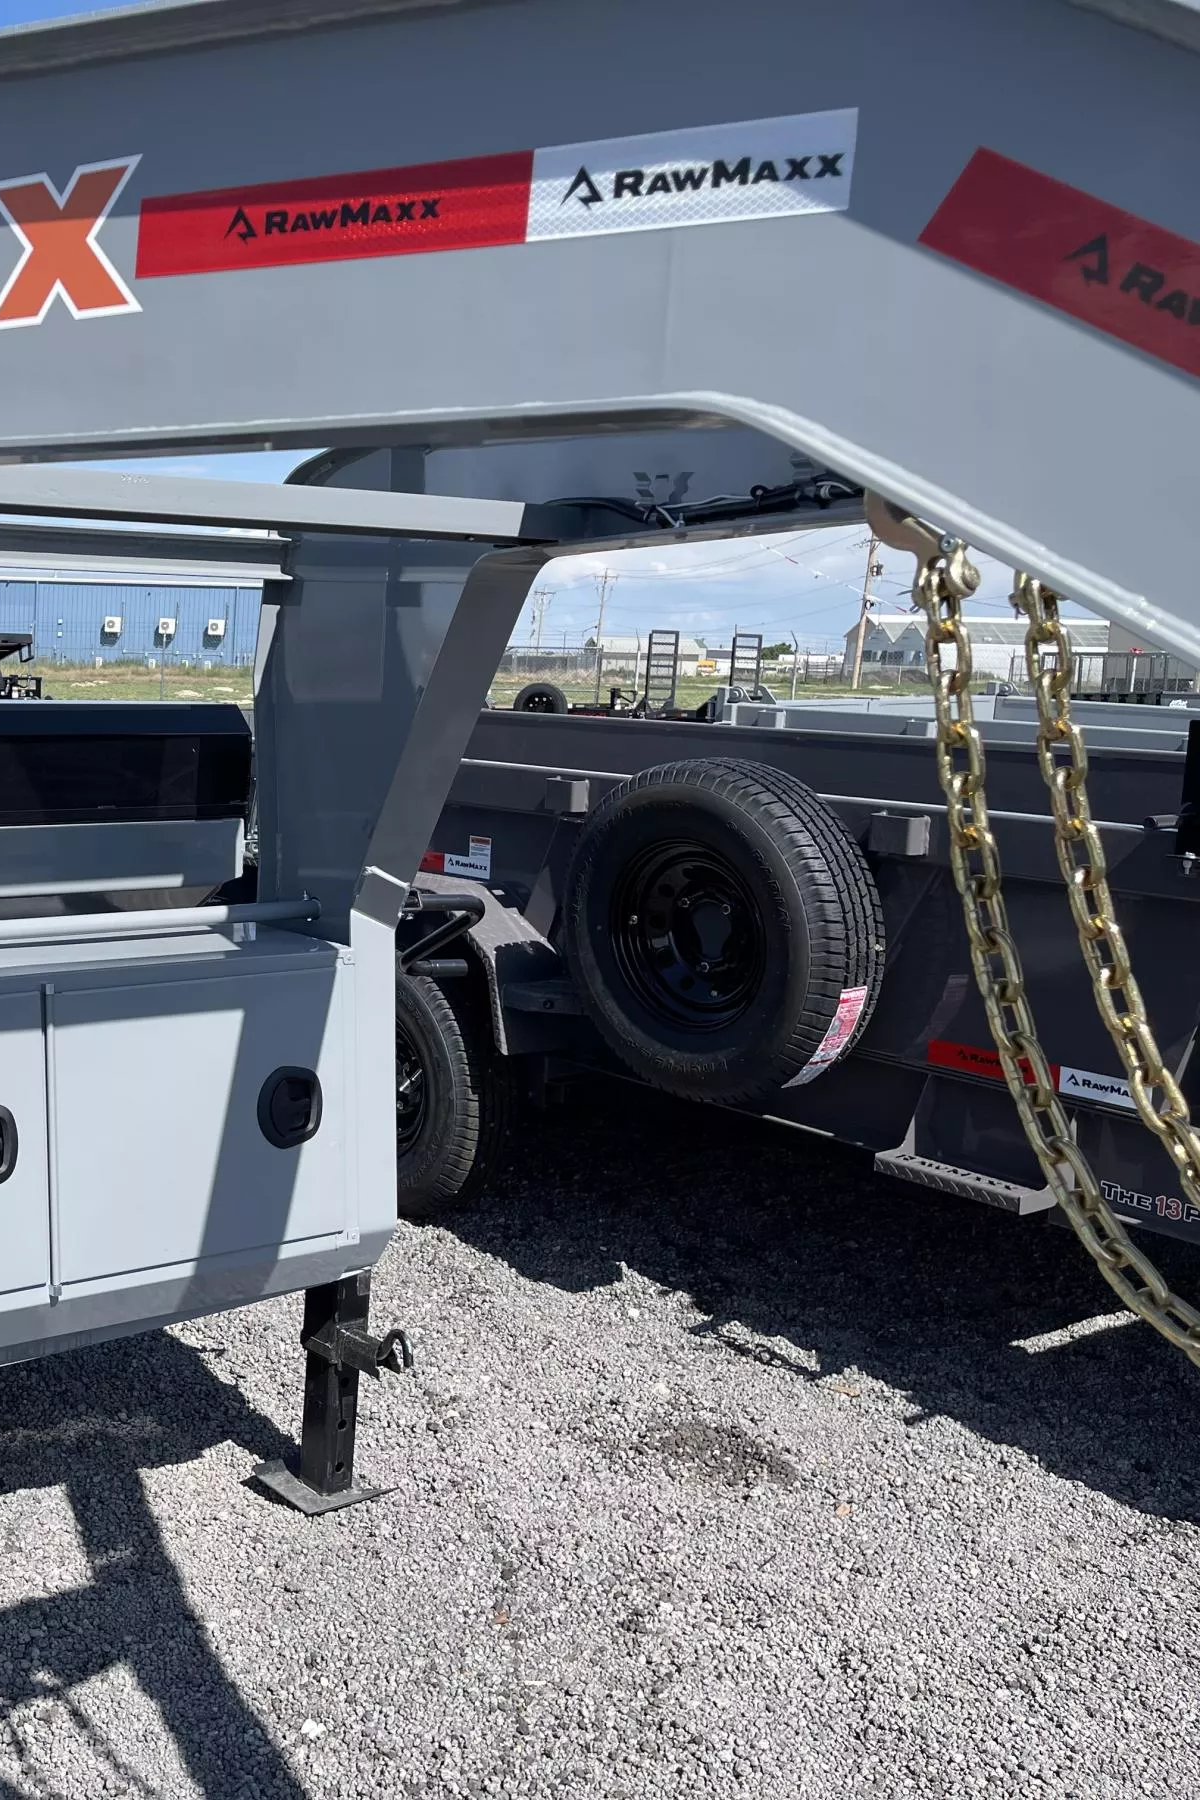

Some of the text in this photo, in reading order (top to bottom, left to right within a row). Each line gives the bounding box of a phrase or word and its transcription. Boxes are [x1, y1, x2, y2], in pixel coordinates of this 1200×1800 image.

[612, 152, 846, 200] RAWMAXX
[263, 197, 442, 237] RAWMAXX
[1119, 262, 1200, 326] RA
[1081, 1079, 1133, 1099] RAWMA
[1100, 1179, 1152, 1211] THE
[1155, 1195, 1182, 1220] 13
